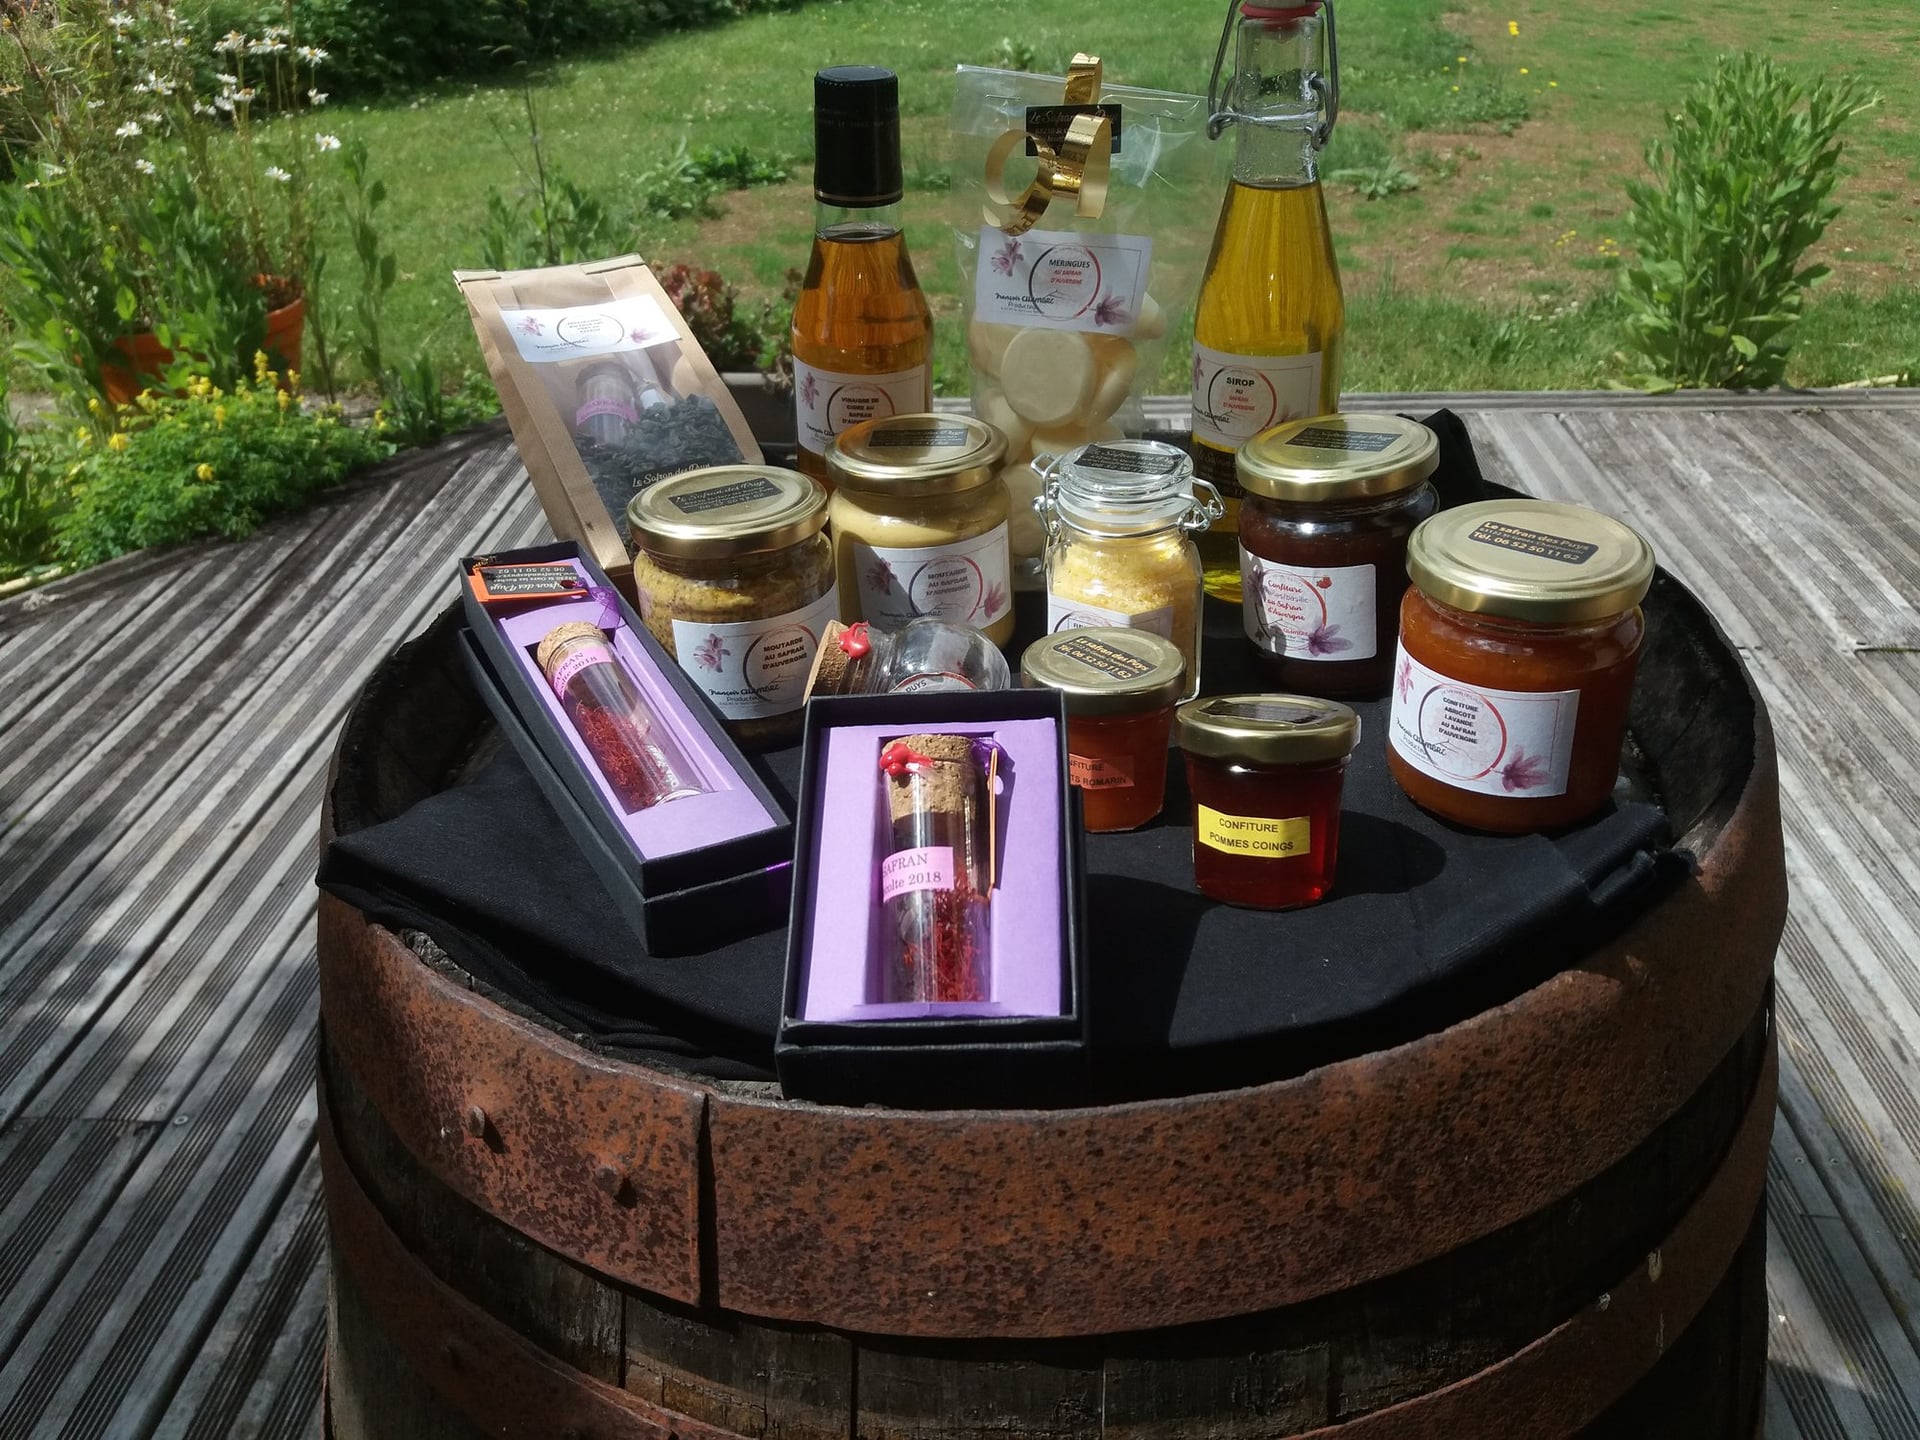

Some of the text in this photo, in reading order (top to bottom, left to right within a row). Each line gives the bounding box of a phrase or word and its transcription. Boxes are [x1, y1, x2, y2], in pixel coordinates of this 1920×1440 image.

[1048, 259, 1091, 269] MERINGUES
[1226, 376, 1256, 387] SIROP
[841, 396, 870, 404] VINAIGRE
[632, 477, 643, 488] Le
[1483, 522, 1591, 551] Le safran des Puys
[1473, 531, 1580, 561] Tél. 06 52 50 11 62
[927, 567, 968, 580] MOUTARDE
[490, 582, 517, 592] Puys
[518, 583, 535, 591] des
[928, 576, 969, 589] AU SAFRAN
[1268, 579, 1304, 594] Confiture
[1276, 600, 1303, 612] Safran
[763, 635, 804, 652] MOUTARDE
[764, 644, 805, 661] AU SAFRAN
[1076, 637, 1149, 671] Le safran des Puys
[762, 652, 808, 670] D'AUVERGNE
[1072, 650, 1084, 658] 06
[1084, 655, 1097, 663] 52
[1096, 660, 1108, 668] 50
[1117, 670, 1132, 679] 62
[905, 679, 927, 693] PUYS
[1442, 696, 1479, 712] CONFITURE
[1444, 706, 1476, 720] ABRICOTS
[1444, 713, 1474, 727] LAVANDE
[1438, 727, 1479, 744] D'AUVERGNE
[1450, 724, 1477, 737] SAFRAN
[1070, 760, 1105, 771] NFITURE
[1082, 775, 1127, 786] ROMARIN
[1219, 818, 1279, 833] CONFITURE
[1209, 831, 1294, 851] POMMES COINGS
[908, 871, 942, 886] 2018
